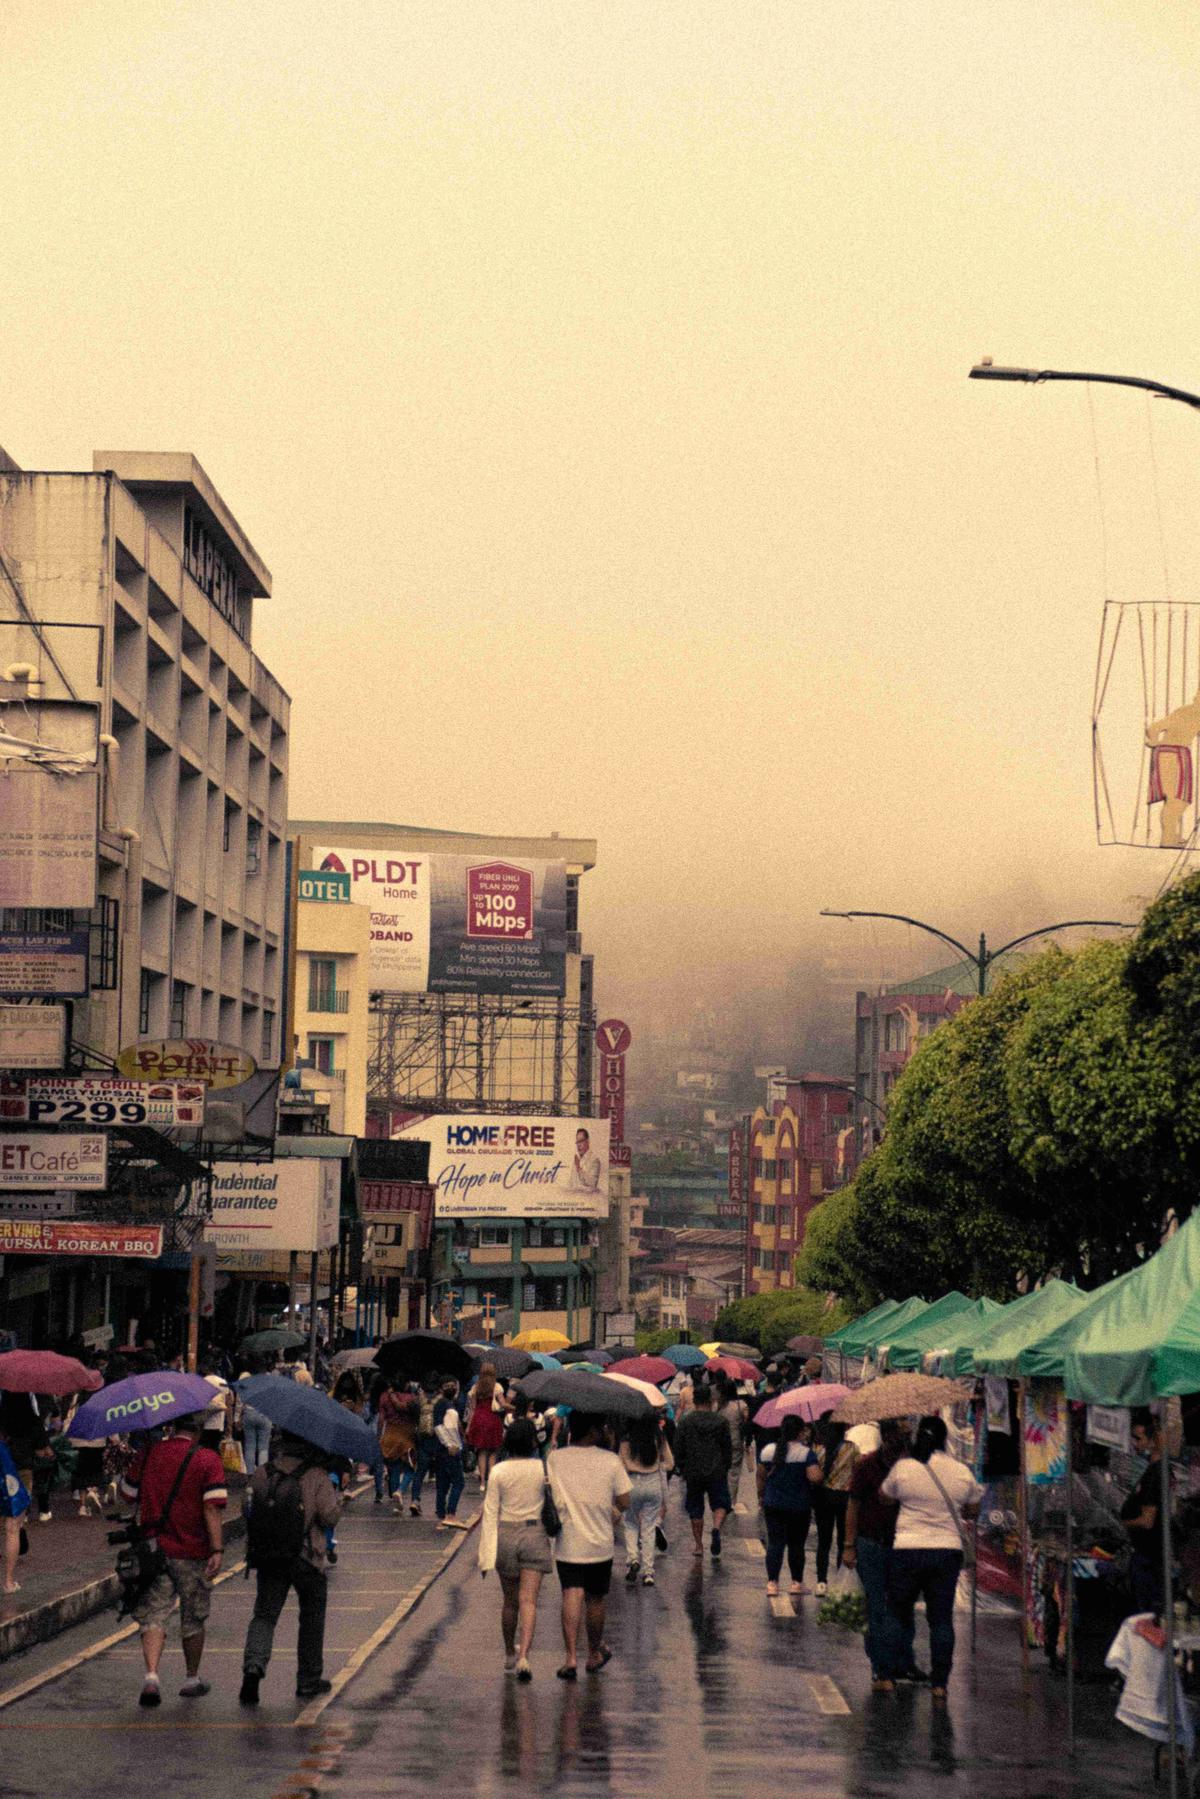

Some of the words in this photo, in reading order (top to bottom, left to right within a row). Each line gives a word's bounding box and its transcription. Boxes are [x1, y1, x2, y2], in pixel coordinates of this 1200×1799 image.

[352, 858, 422, 885] PLDT
[479, 873, 500, 881] FIBER
[383, 887, 417, 899] Home
[479, 882, 500, 890] PLAN
[501, 883, 520, 892] 2099
[472, 893, 484, 902] up
[474, 901, 484, 909] to
[485, 894, 516, 911] 100
[475, 912, 526, 932] Mbps
[603, 1026, 625, 1050] V
[28, 1079, 76, 1089] POINT
[82, 1079, 95, 1089] &
[99, 1080, 146, 1091] GRILL
[28, 1088, 145, 1098] SAMGYUPSAL
[605, 1057, 621, 1142] HOTEL
[28, 1100, 146, 1124] P299
[446, 1125, 500, 1146] HOME
[504, 1126, 555, 1148] FREE
[82, 1145, 101, 1155] 24
[437, 1163, 488, 1201] Hope
[488, 1170, 502, 1184] in
[502, 1158, 569, 1191] Christ
[719, 1205, 741, 1216] INN
[57, 1239, 118, 1251] KOREAN
[123, 1241, 155, 1254] BBQ
[106, 1391, 176, 1423] maya
